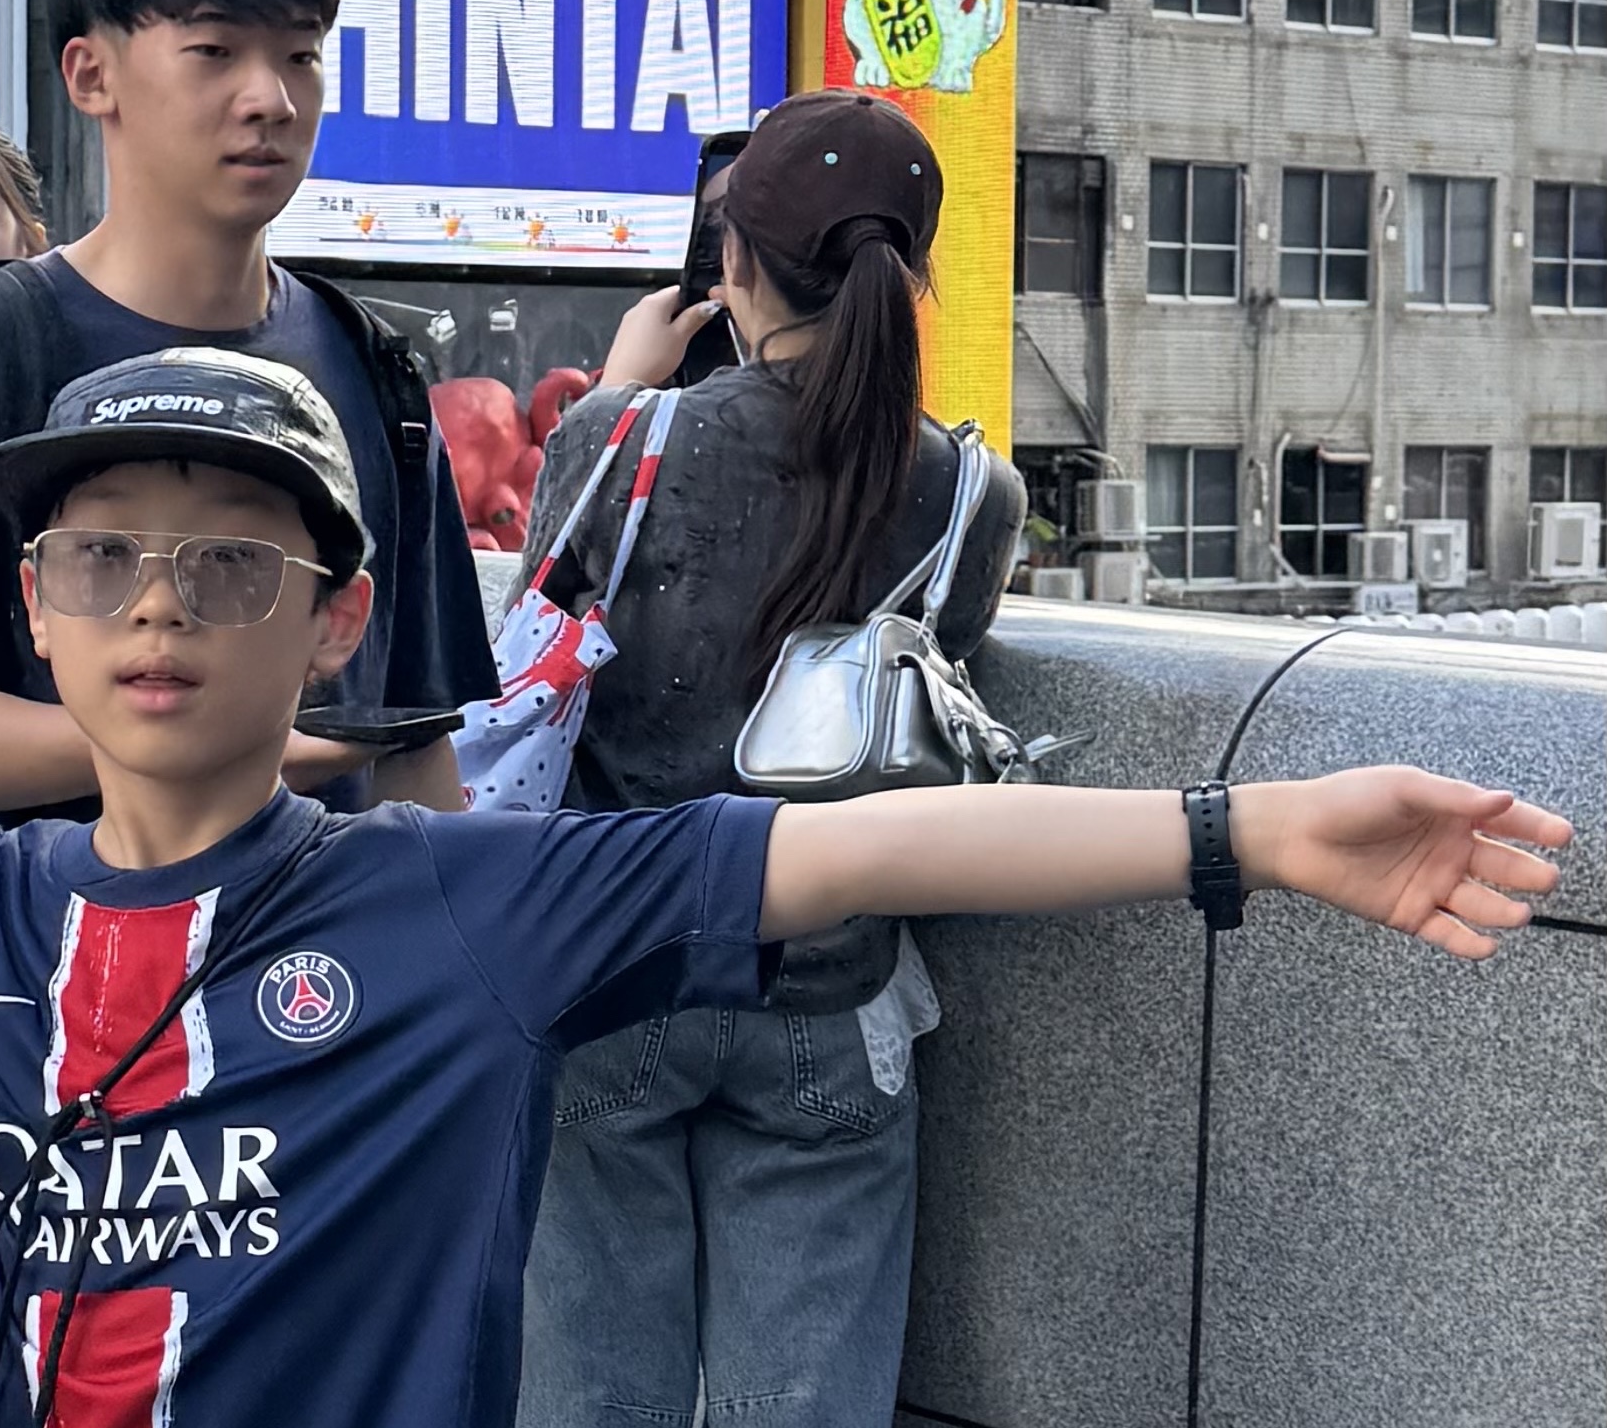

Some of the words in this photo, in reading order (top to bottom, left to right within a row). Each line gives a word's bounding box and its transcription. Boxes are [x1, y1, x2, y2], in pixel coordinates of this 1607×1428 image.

[90, 393, 225, 424] Supreme
[269, 956, 331, 985] PARIS
[23, 1207, 281, 1266] AIRWAYS
